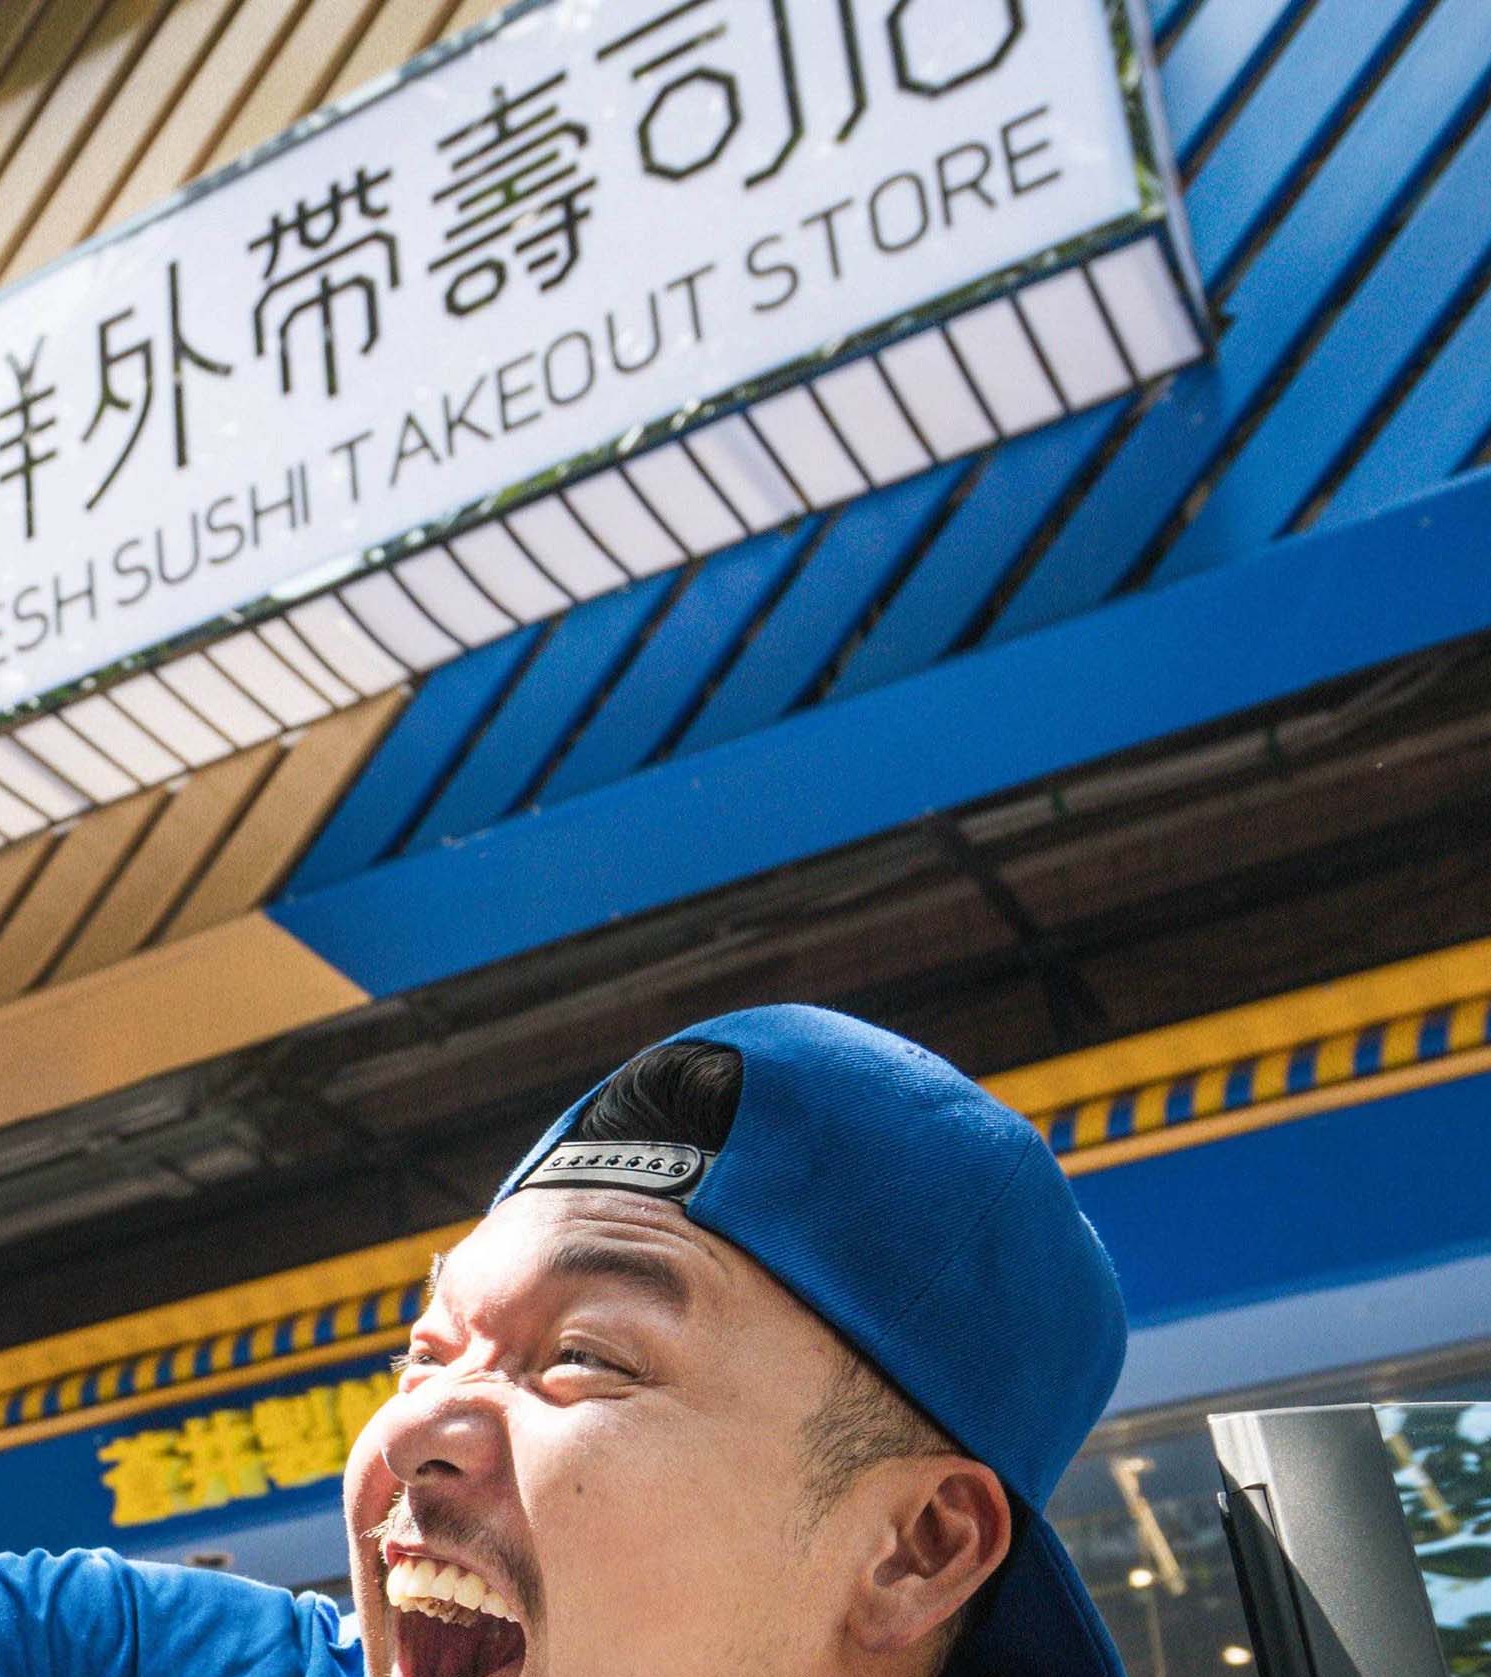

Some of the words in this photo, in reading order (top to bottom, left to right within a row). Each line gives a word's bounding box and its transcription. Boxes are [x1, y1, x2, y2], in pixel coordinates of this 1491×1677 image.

[111, 461, 310, 605] SUSHI
[330, 263, 716, 501] TAKEOUT
[744, 104, 1062, 313] STORE
